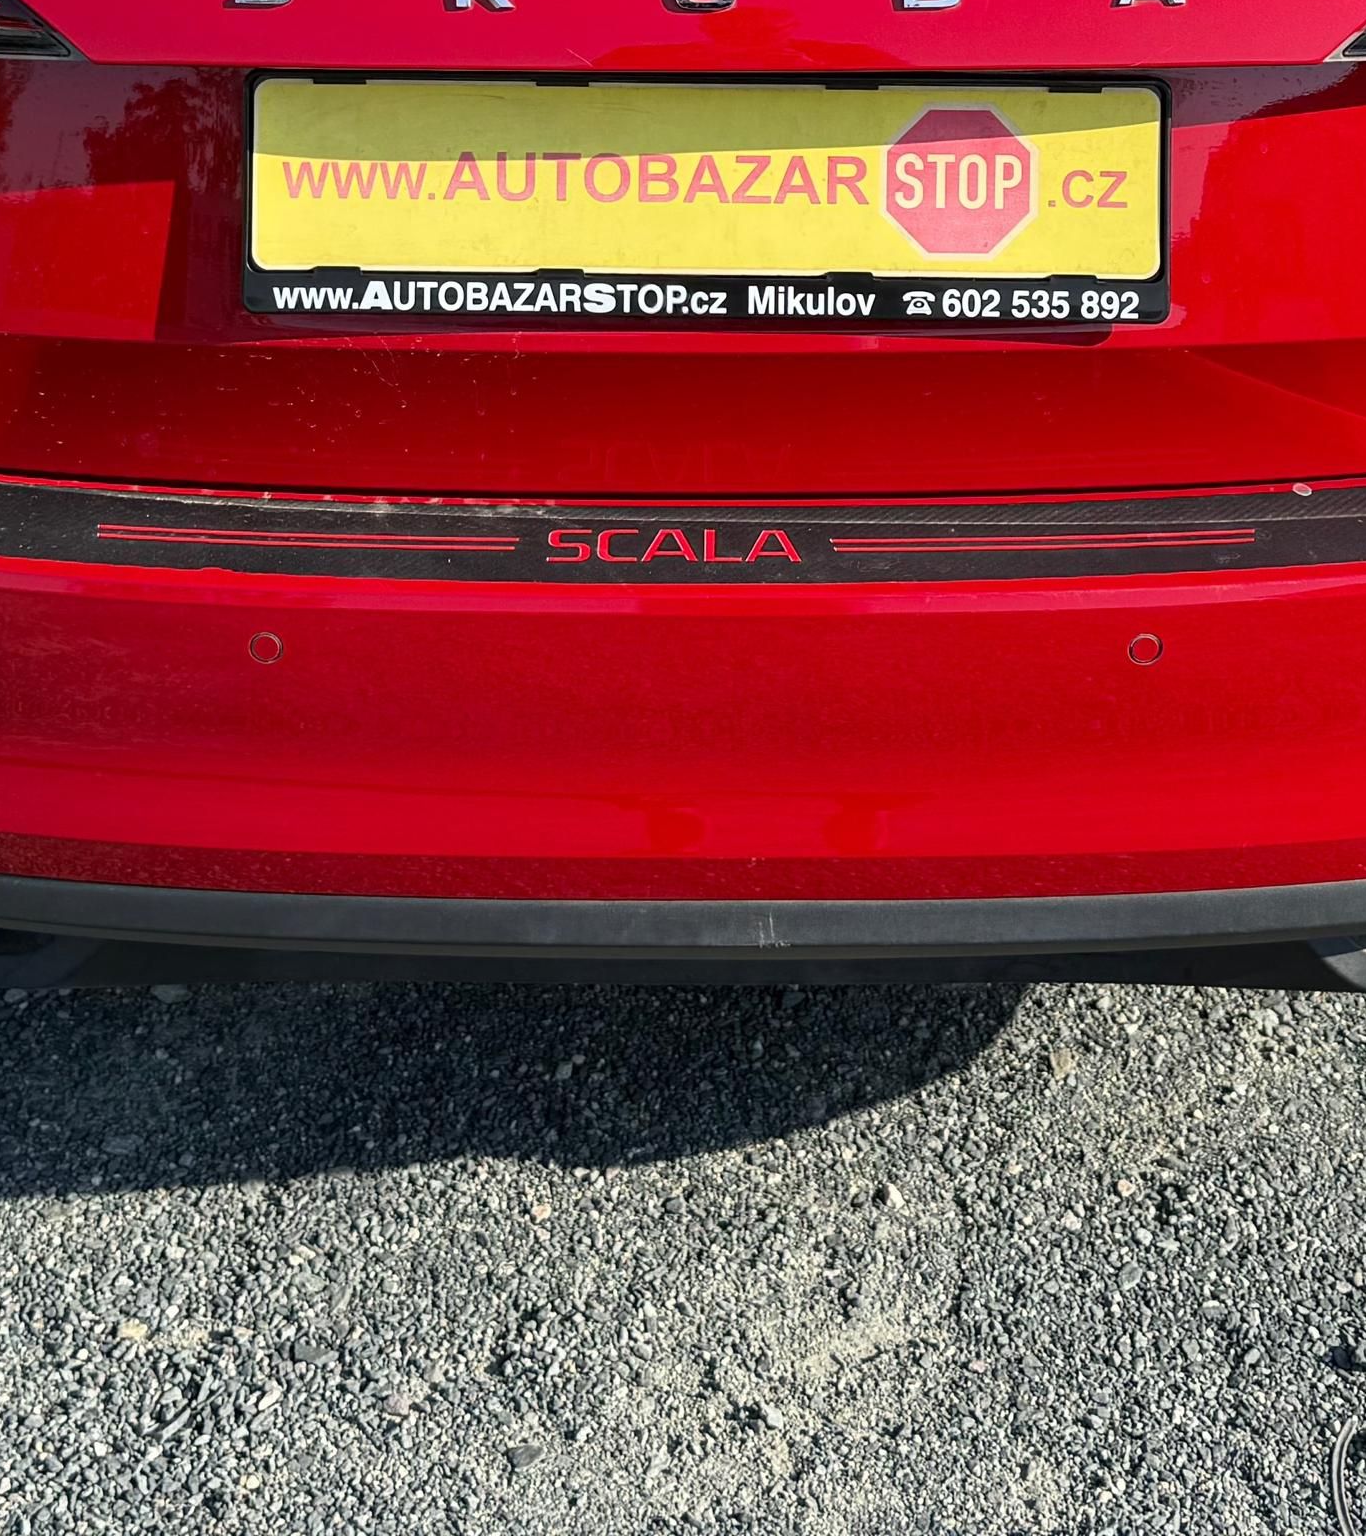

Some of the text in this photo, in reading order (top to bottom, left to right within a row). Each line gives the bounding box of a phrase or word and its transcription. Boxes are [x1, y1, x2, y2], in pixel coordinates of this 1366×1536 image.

[893, 152, 1023, 211] STOP
[272, 280, 1140, 321] www.AUTOBAZARSTOP.cz Mikulov 602 535 892
[545, 528, 803, 563] SCALA
